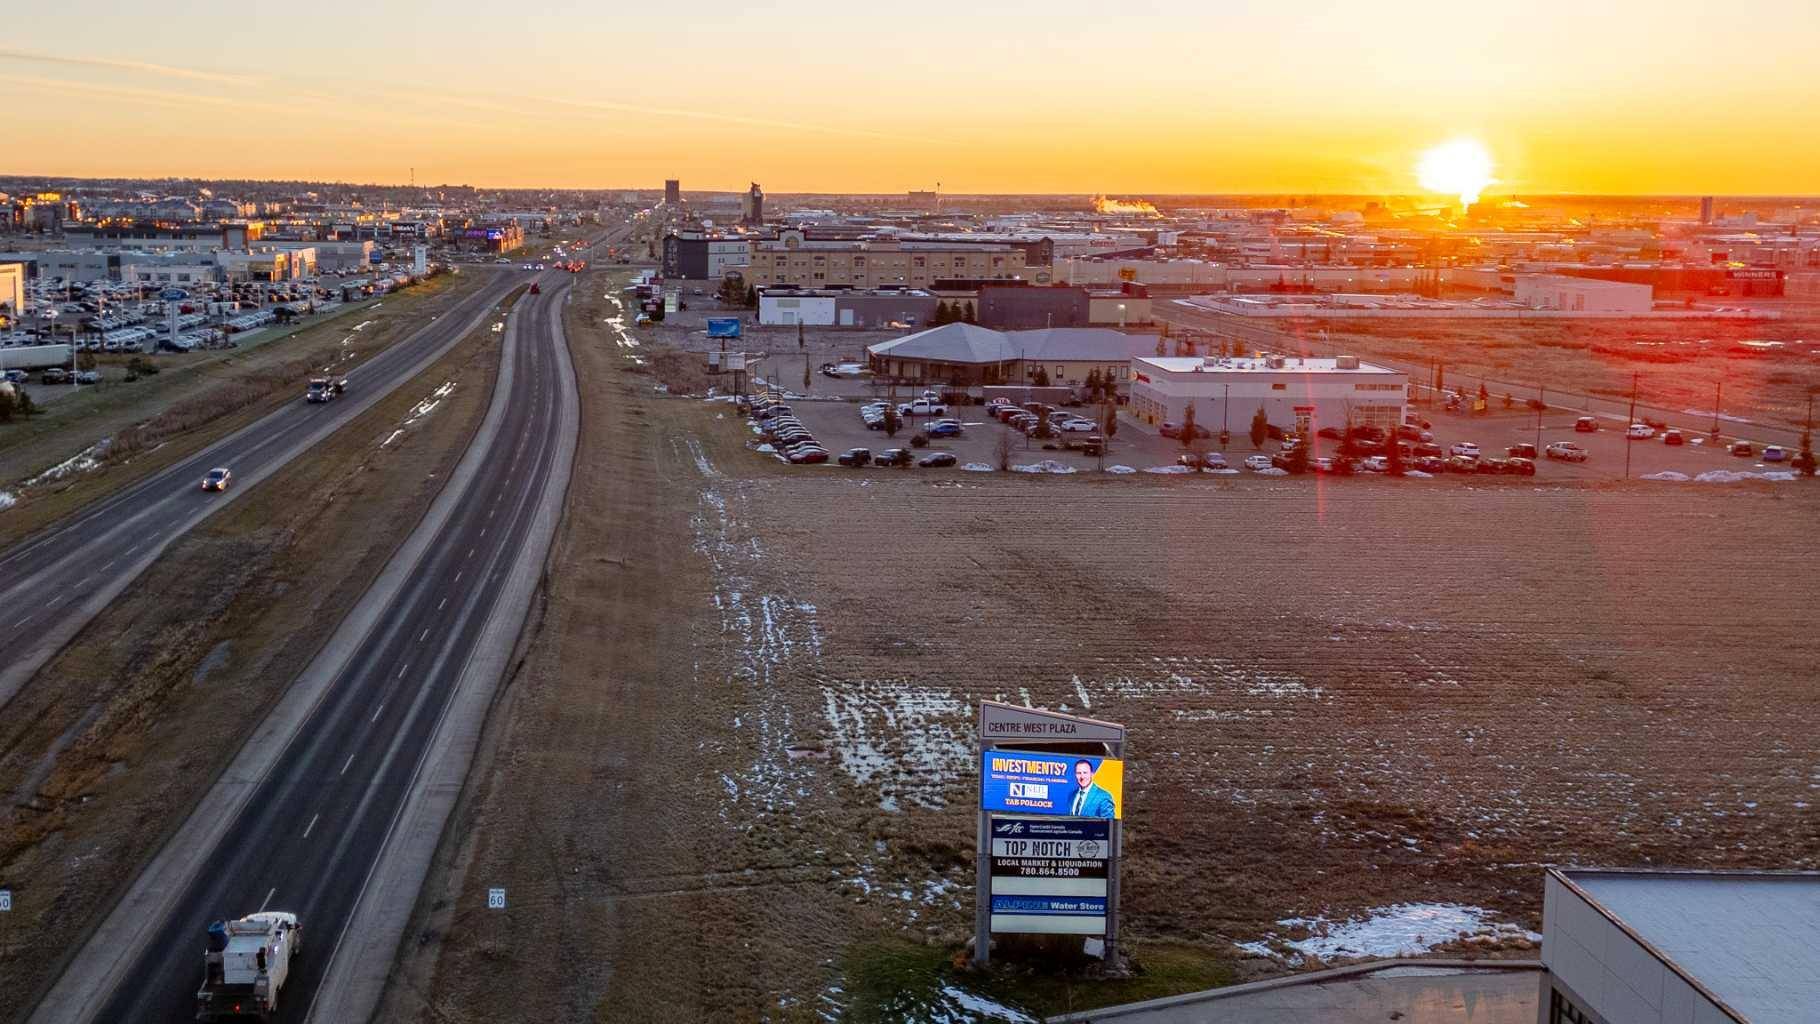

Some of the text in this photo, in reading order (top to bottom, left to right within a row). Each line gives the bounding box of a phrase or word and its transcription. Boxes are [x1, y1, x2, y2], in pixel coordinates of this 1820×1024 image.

[1733, 271, 1776, 279] WINNERS
[988, 722, 1077, 734] CENTRE WEST PLAZA
[992, 758, 1067, 776] INVESTMENTS?
[1005, 798, 1053, 808] TAB POLLOCK
[1004, 840, 1027, 856] TOP
[1032, 841, 1071, 857] NOTCH
[1021, 859, 1050, 867] MARKET
[1058, 860, 1103, 868] LIQUIDATION
[490, 895, 504, 905] 60
[1050, 902, 1078, 910] Water
[1080, 902, 1105, 910] Store
